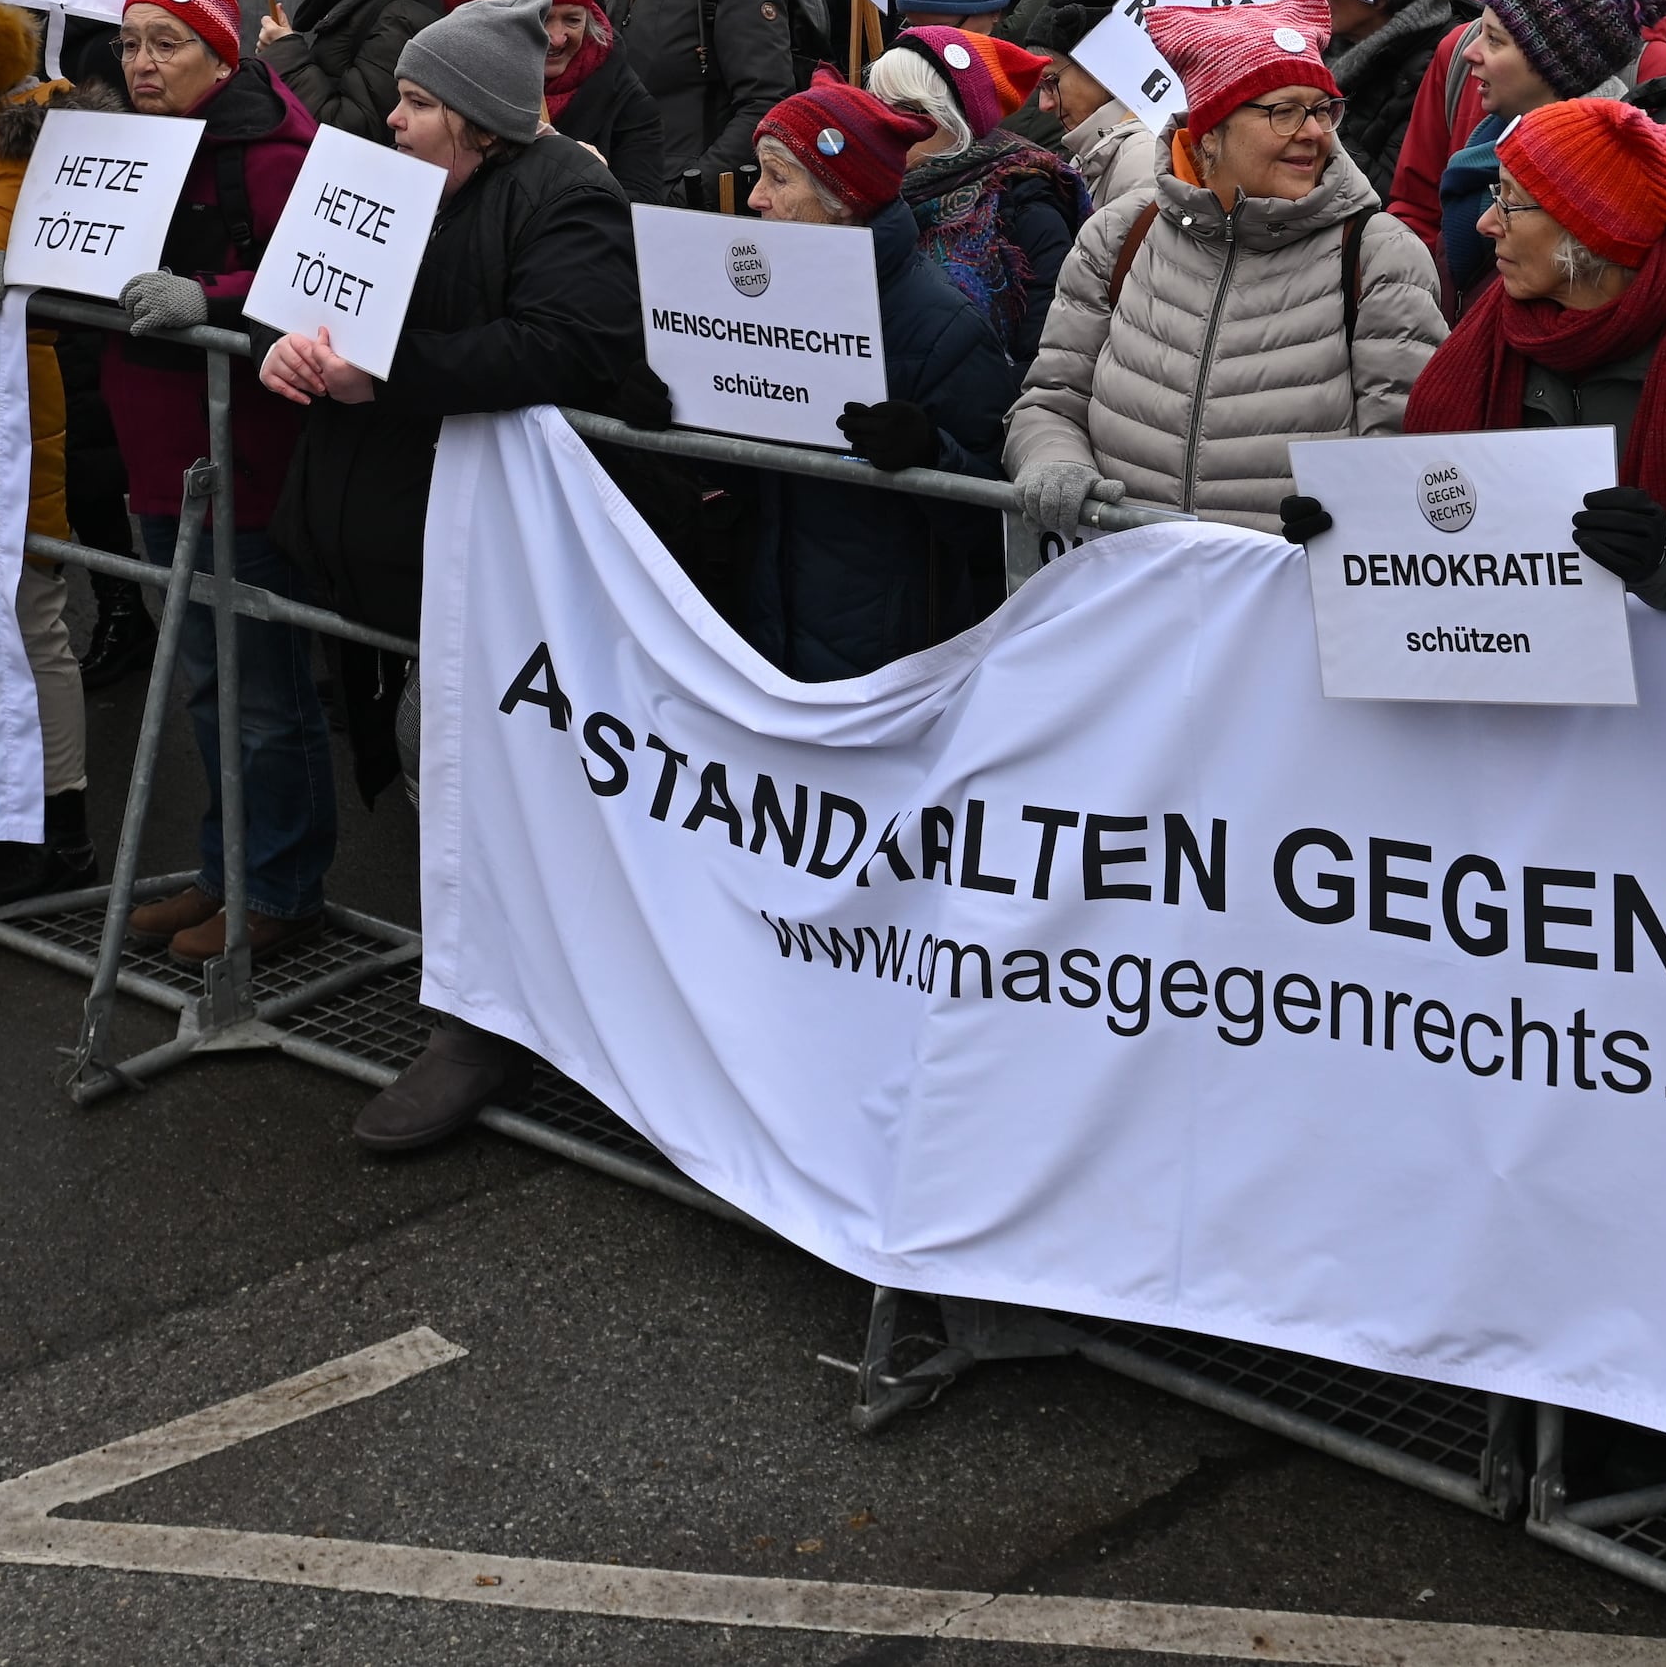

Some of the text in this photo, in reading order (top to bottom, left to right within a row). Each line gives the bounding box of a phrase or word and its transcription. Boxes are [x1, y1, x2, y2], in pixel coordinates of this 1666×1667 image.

[55, 155, 149, 193] HETZE
[314, 183, 396, 245] HETZE
[34, 212, 125, 257] TÖTET
[731, 244, 757, 258] OMAS
[733, 259, 763, 273] GEGEN
[734, 273, 768, 287] RECHTS
[290, 250, 374, 317] TÖTET
[652, 308, 872, 359] MENSCHENRECHTE
[713, 373, 809, 404] schützen
[1424, 467, 1458, 485] OMAS
[1427, 486, 1465, 505] GEGEN
[1429, 503, 1472, 523] RECHTS
[1343, 553, 1582, 587] DEMOKRATIE
[1406, 626, 1531, 653] schützen
